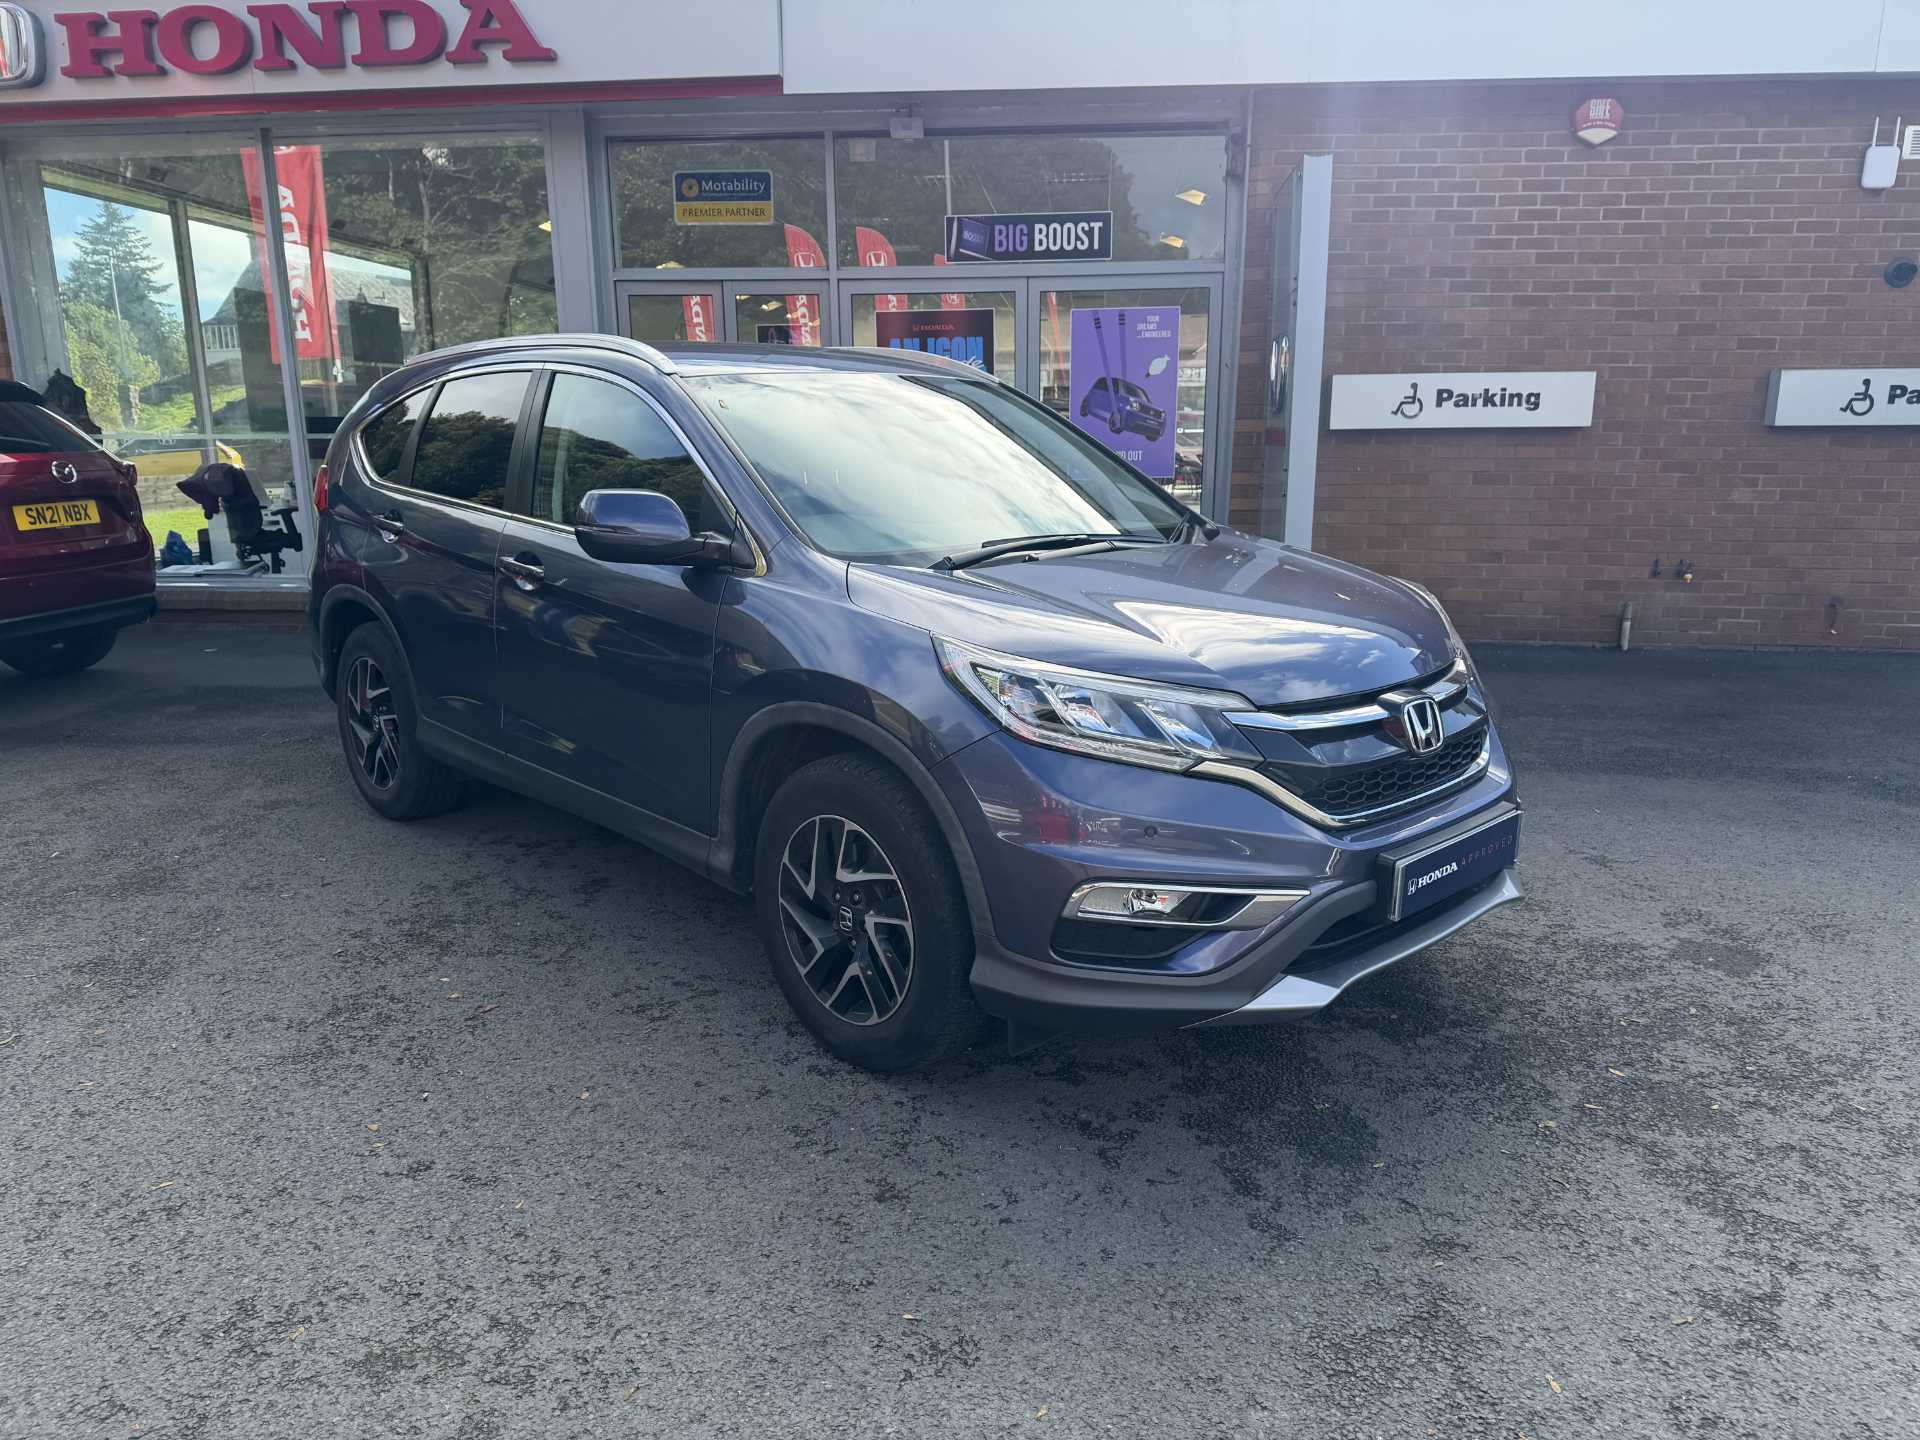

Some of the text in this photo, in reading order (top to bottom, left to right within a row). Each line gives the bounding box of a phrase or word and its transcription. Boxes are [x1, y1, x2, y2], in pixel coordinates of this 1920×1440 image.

[54, 0, 557, 78] HONDA
[702, 177, 766, 193] Motability
[683, 207, 767, 217] PREMIER PARTNER
[994, 222, 1103, 252] BIG BOOST
[1435, 387, 1541, 411] Parking
[1127, 450, 1143, 461] OUT
[25, 503, 92, 525] SN21 NBX
[1418, 862, 1458, 888] HONDA
